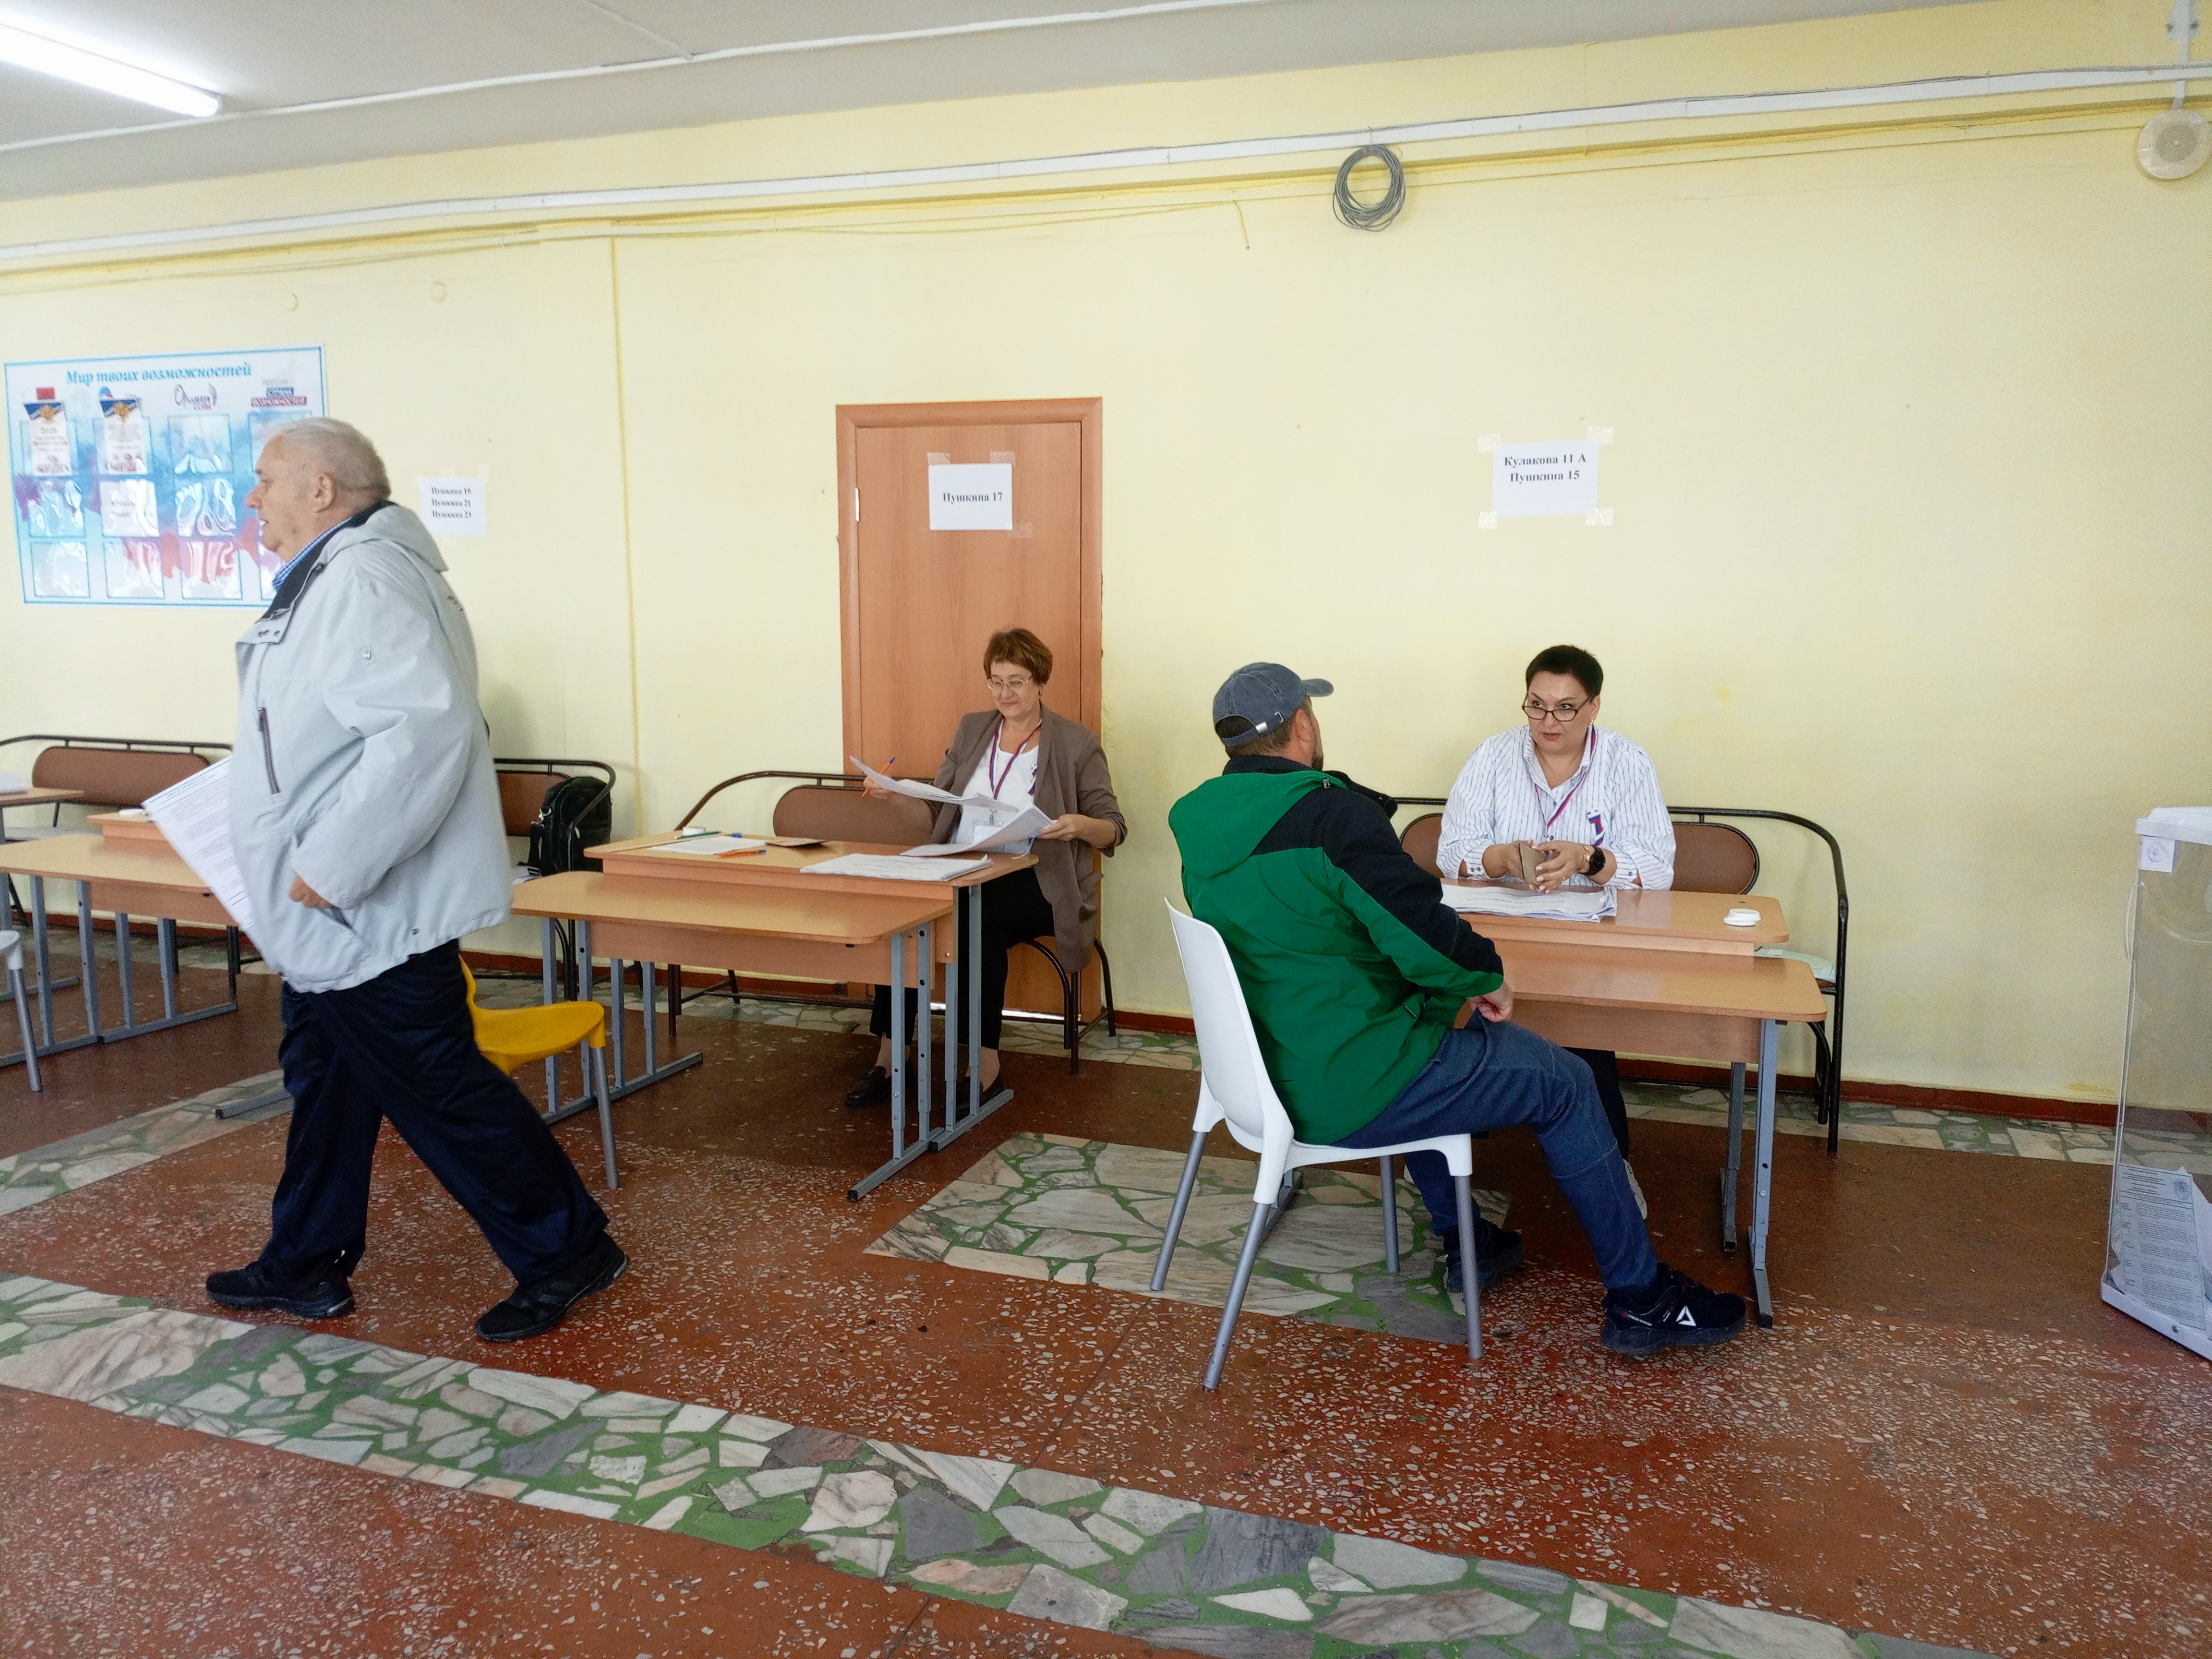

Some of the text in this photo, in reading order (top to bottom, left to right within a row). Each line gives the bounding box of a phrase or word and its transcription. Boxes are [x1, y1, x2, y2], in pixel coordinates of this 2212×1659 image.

[66, 361, 252, 386] Мир твоих возможностей
[1504, 457, 1558, 468] Кулакова
[1563, 454, 1573, 463] 11
[1511, 470, 1580, 484] Пушкина 15
[432, 487, 462, 496] Пушкина
[432, 498, 463, 507] Пушкина
[943, 492, 1003, 505] Пушкина 17
[432, 510, 463, 519] Пушкина
